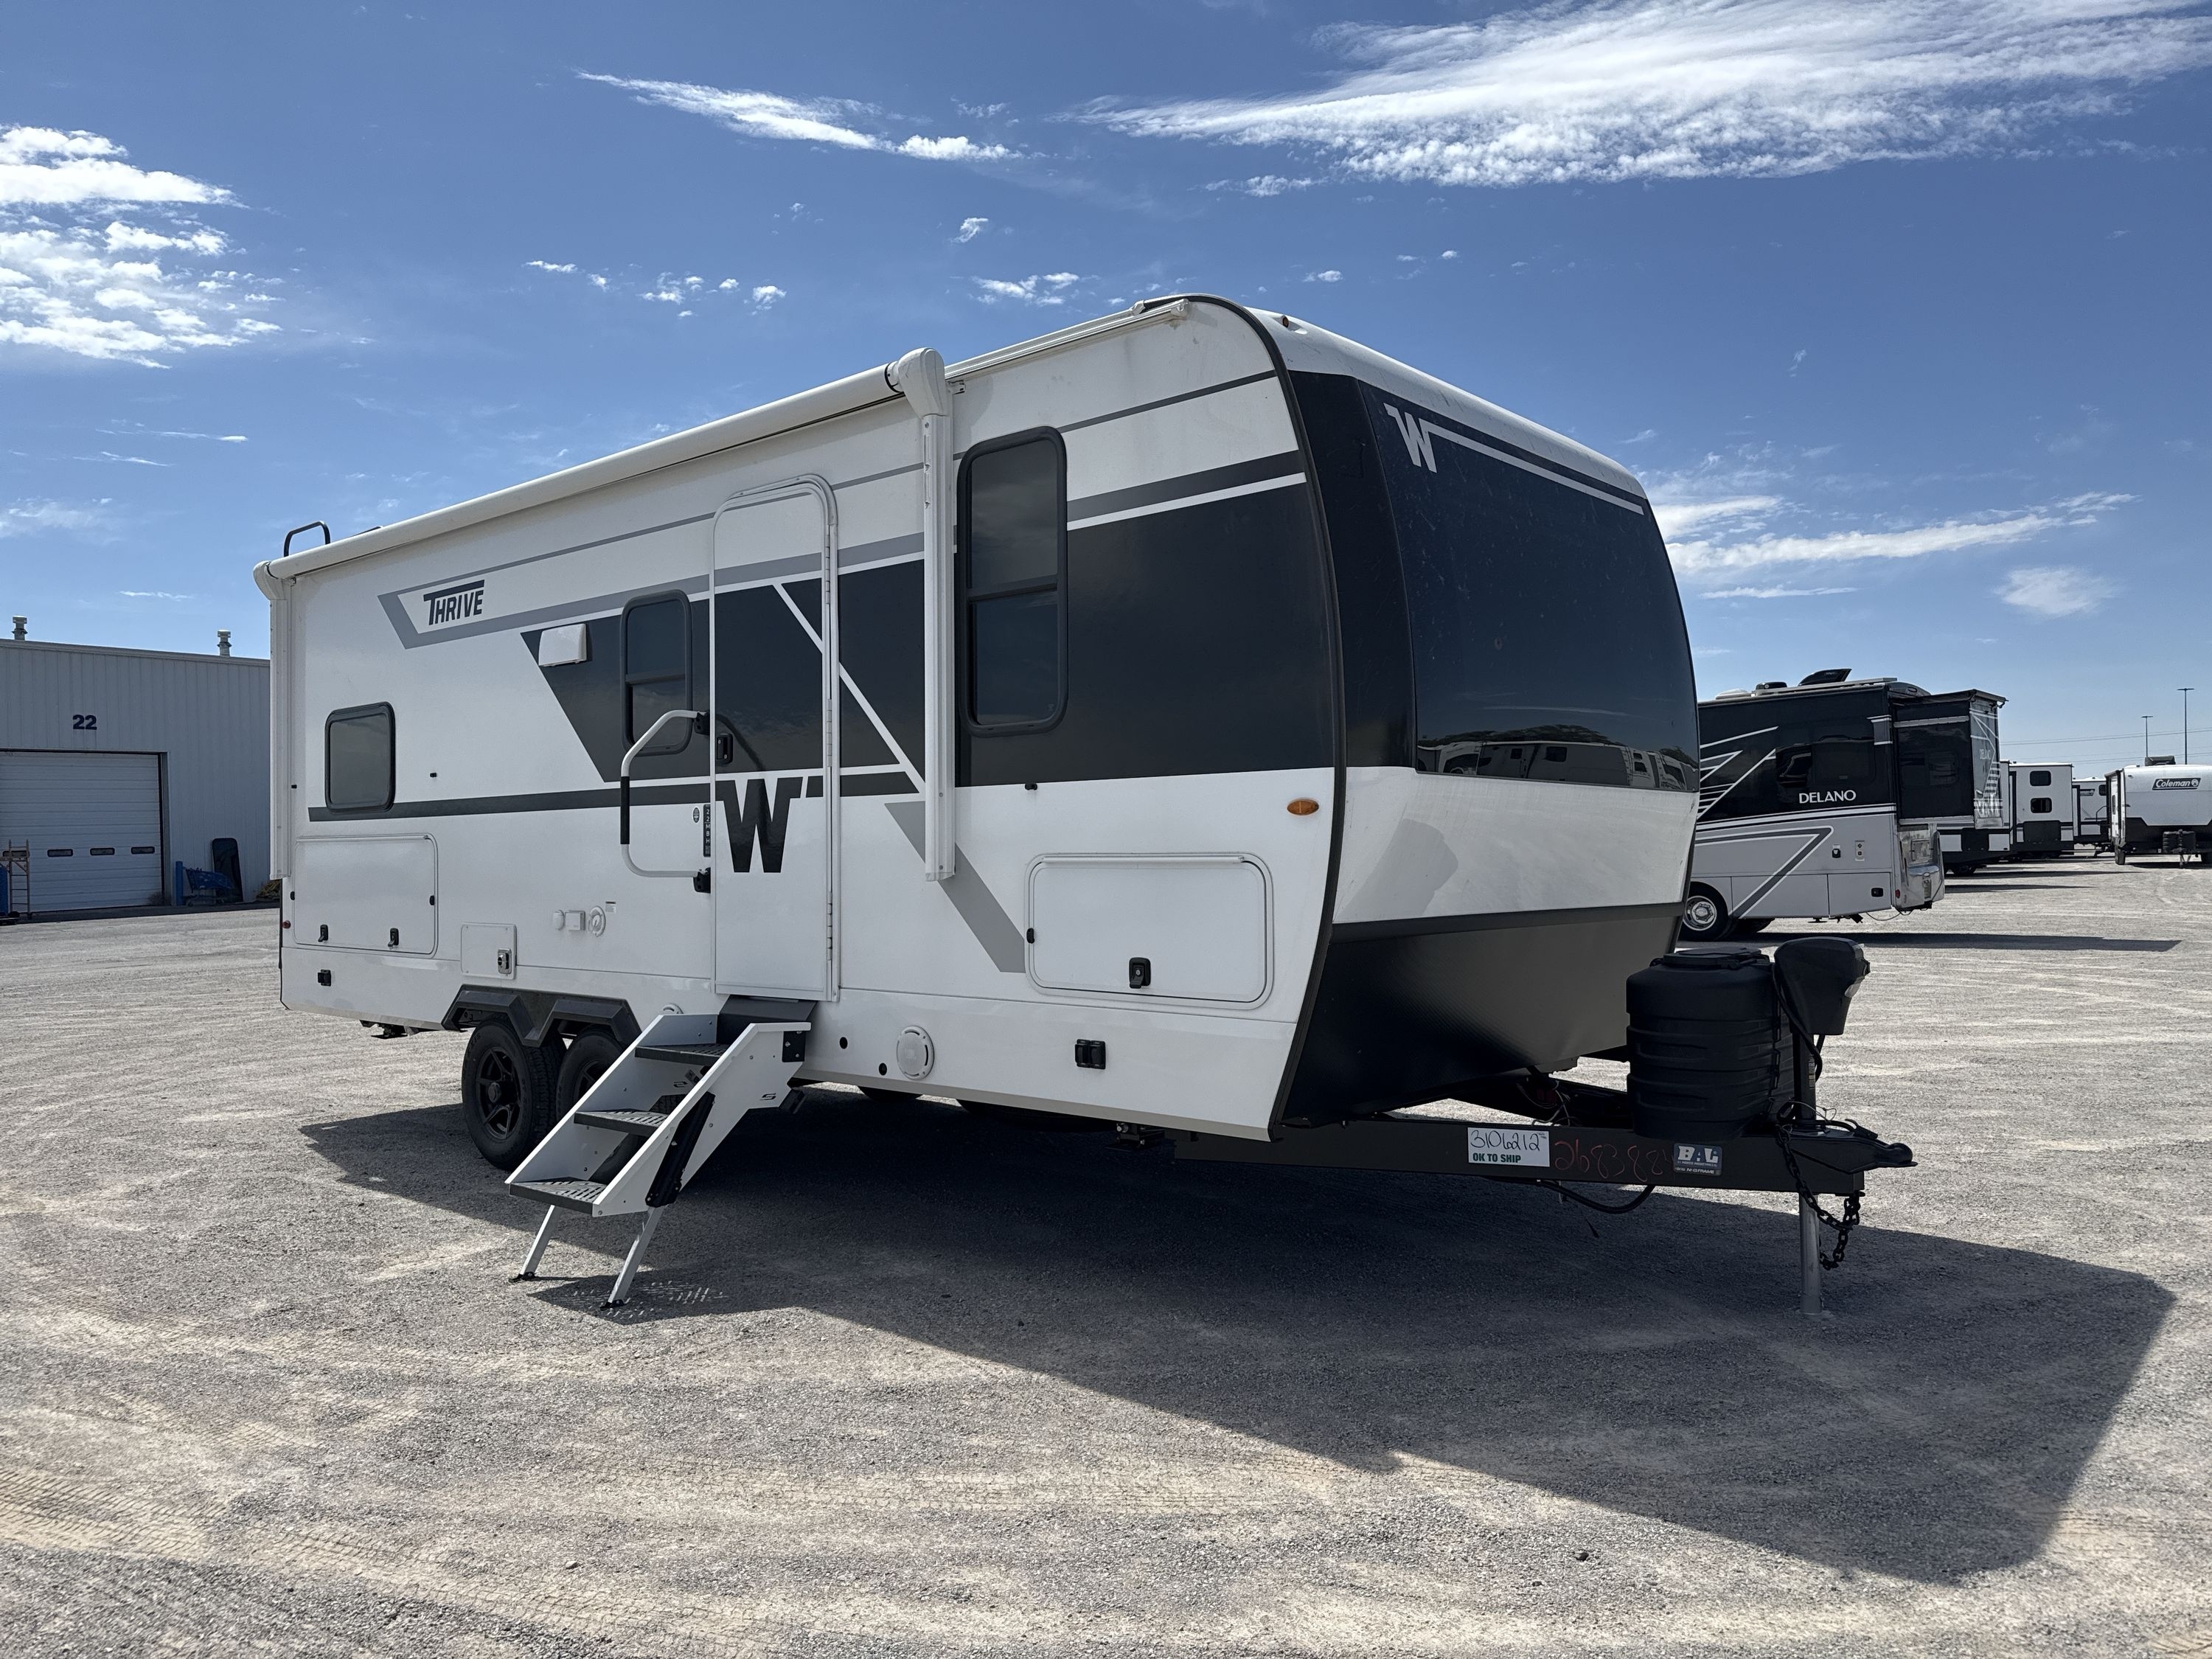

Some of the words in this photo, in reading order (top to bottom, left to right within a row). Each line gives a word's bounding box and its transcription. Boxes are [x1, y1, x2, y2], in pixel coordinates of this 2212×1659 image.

[1383, 402, 1437, 473] W
[423, 580, 484, 625] THRIVE
[72, 714, 97, 731] 22
[2155, 779, 2191, 788] Coleman
[1798, 790, 1857, 804] DELANO
[715, 776, 803, 873] W
[1470, 1130, 1540, 1152] 3106212
[1472, 1152, 1485, 1161] OK
[1487, 1154, 1498, 1162] TO
[1500, 1154, 1521, 1163] SHIP
[1677, 1145, 1719, 1164] BAL
